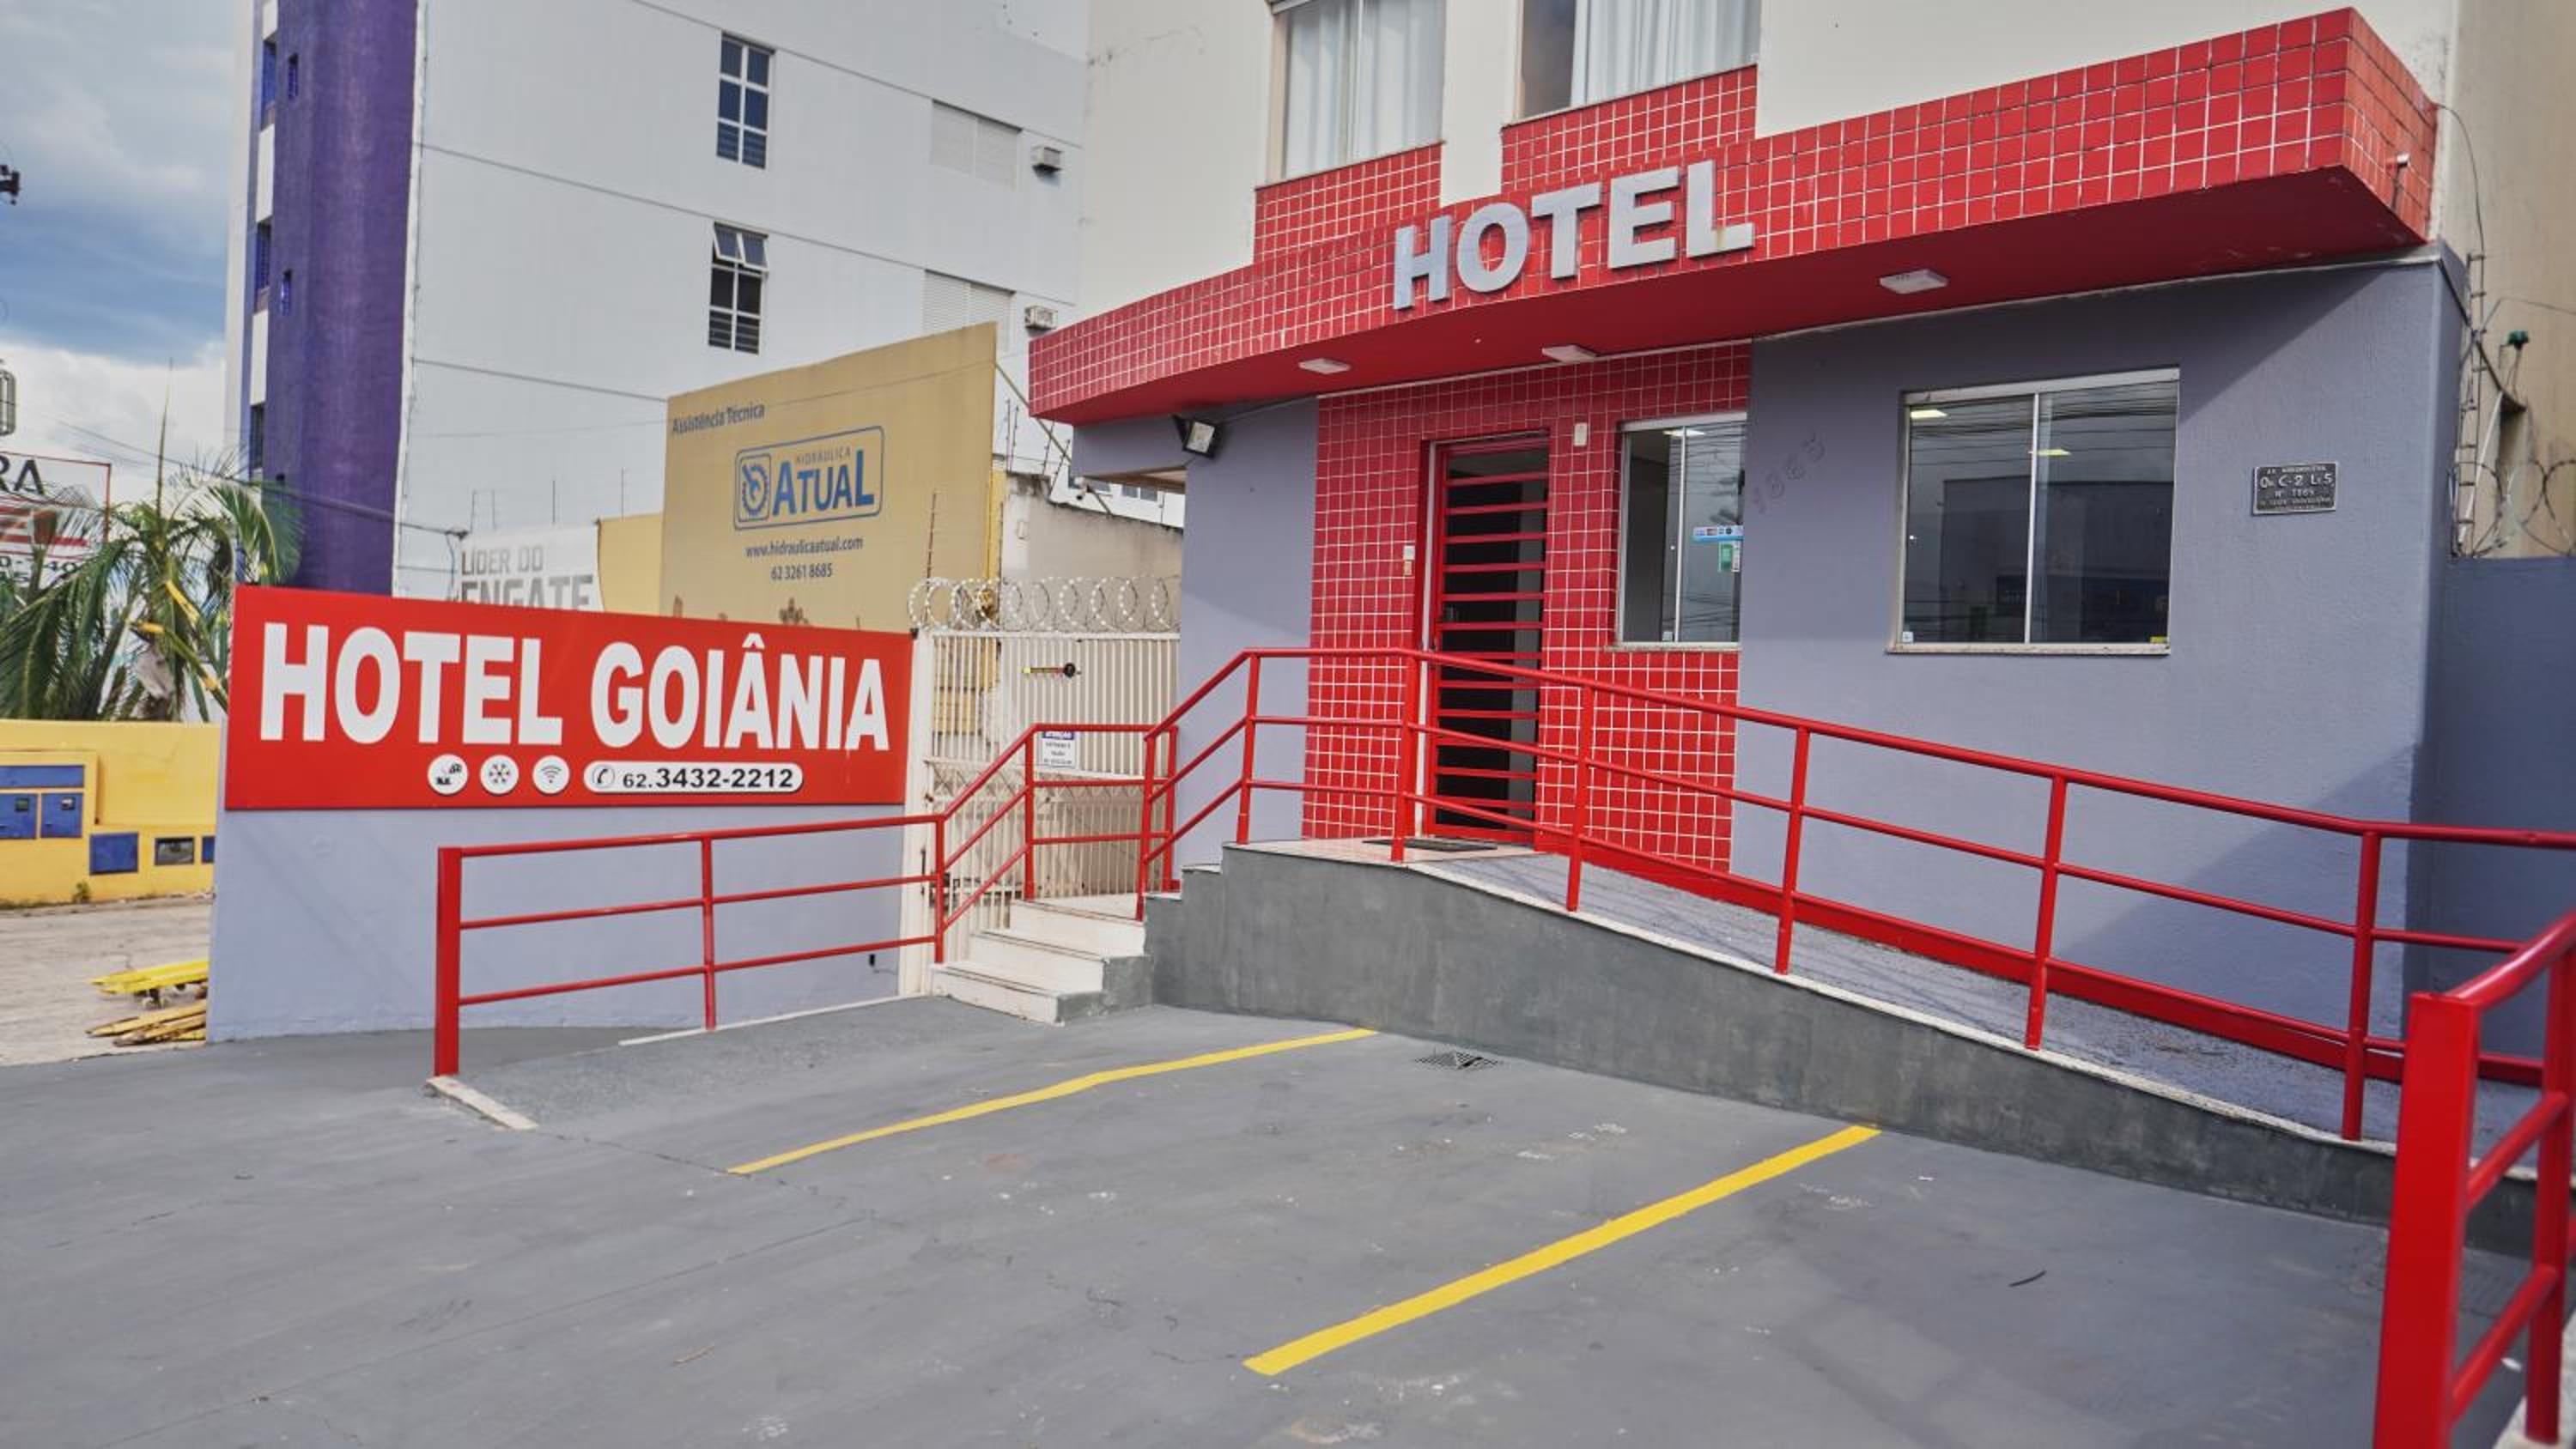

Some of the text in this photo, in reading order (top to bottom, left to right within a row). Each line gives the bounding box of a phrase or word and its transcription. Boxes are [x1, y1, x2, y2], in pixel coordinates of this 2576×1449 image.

[1393, 160, 1755, 311] HOTEL
[745, 536, 863, 557] www.hidraulicaatual.com
[770, 562, 832, 580] 62 3261 8685
[259, 621, 890, 751] HOTEL GOIÂNIA
